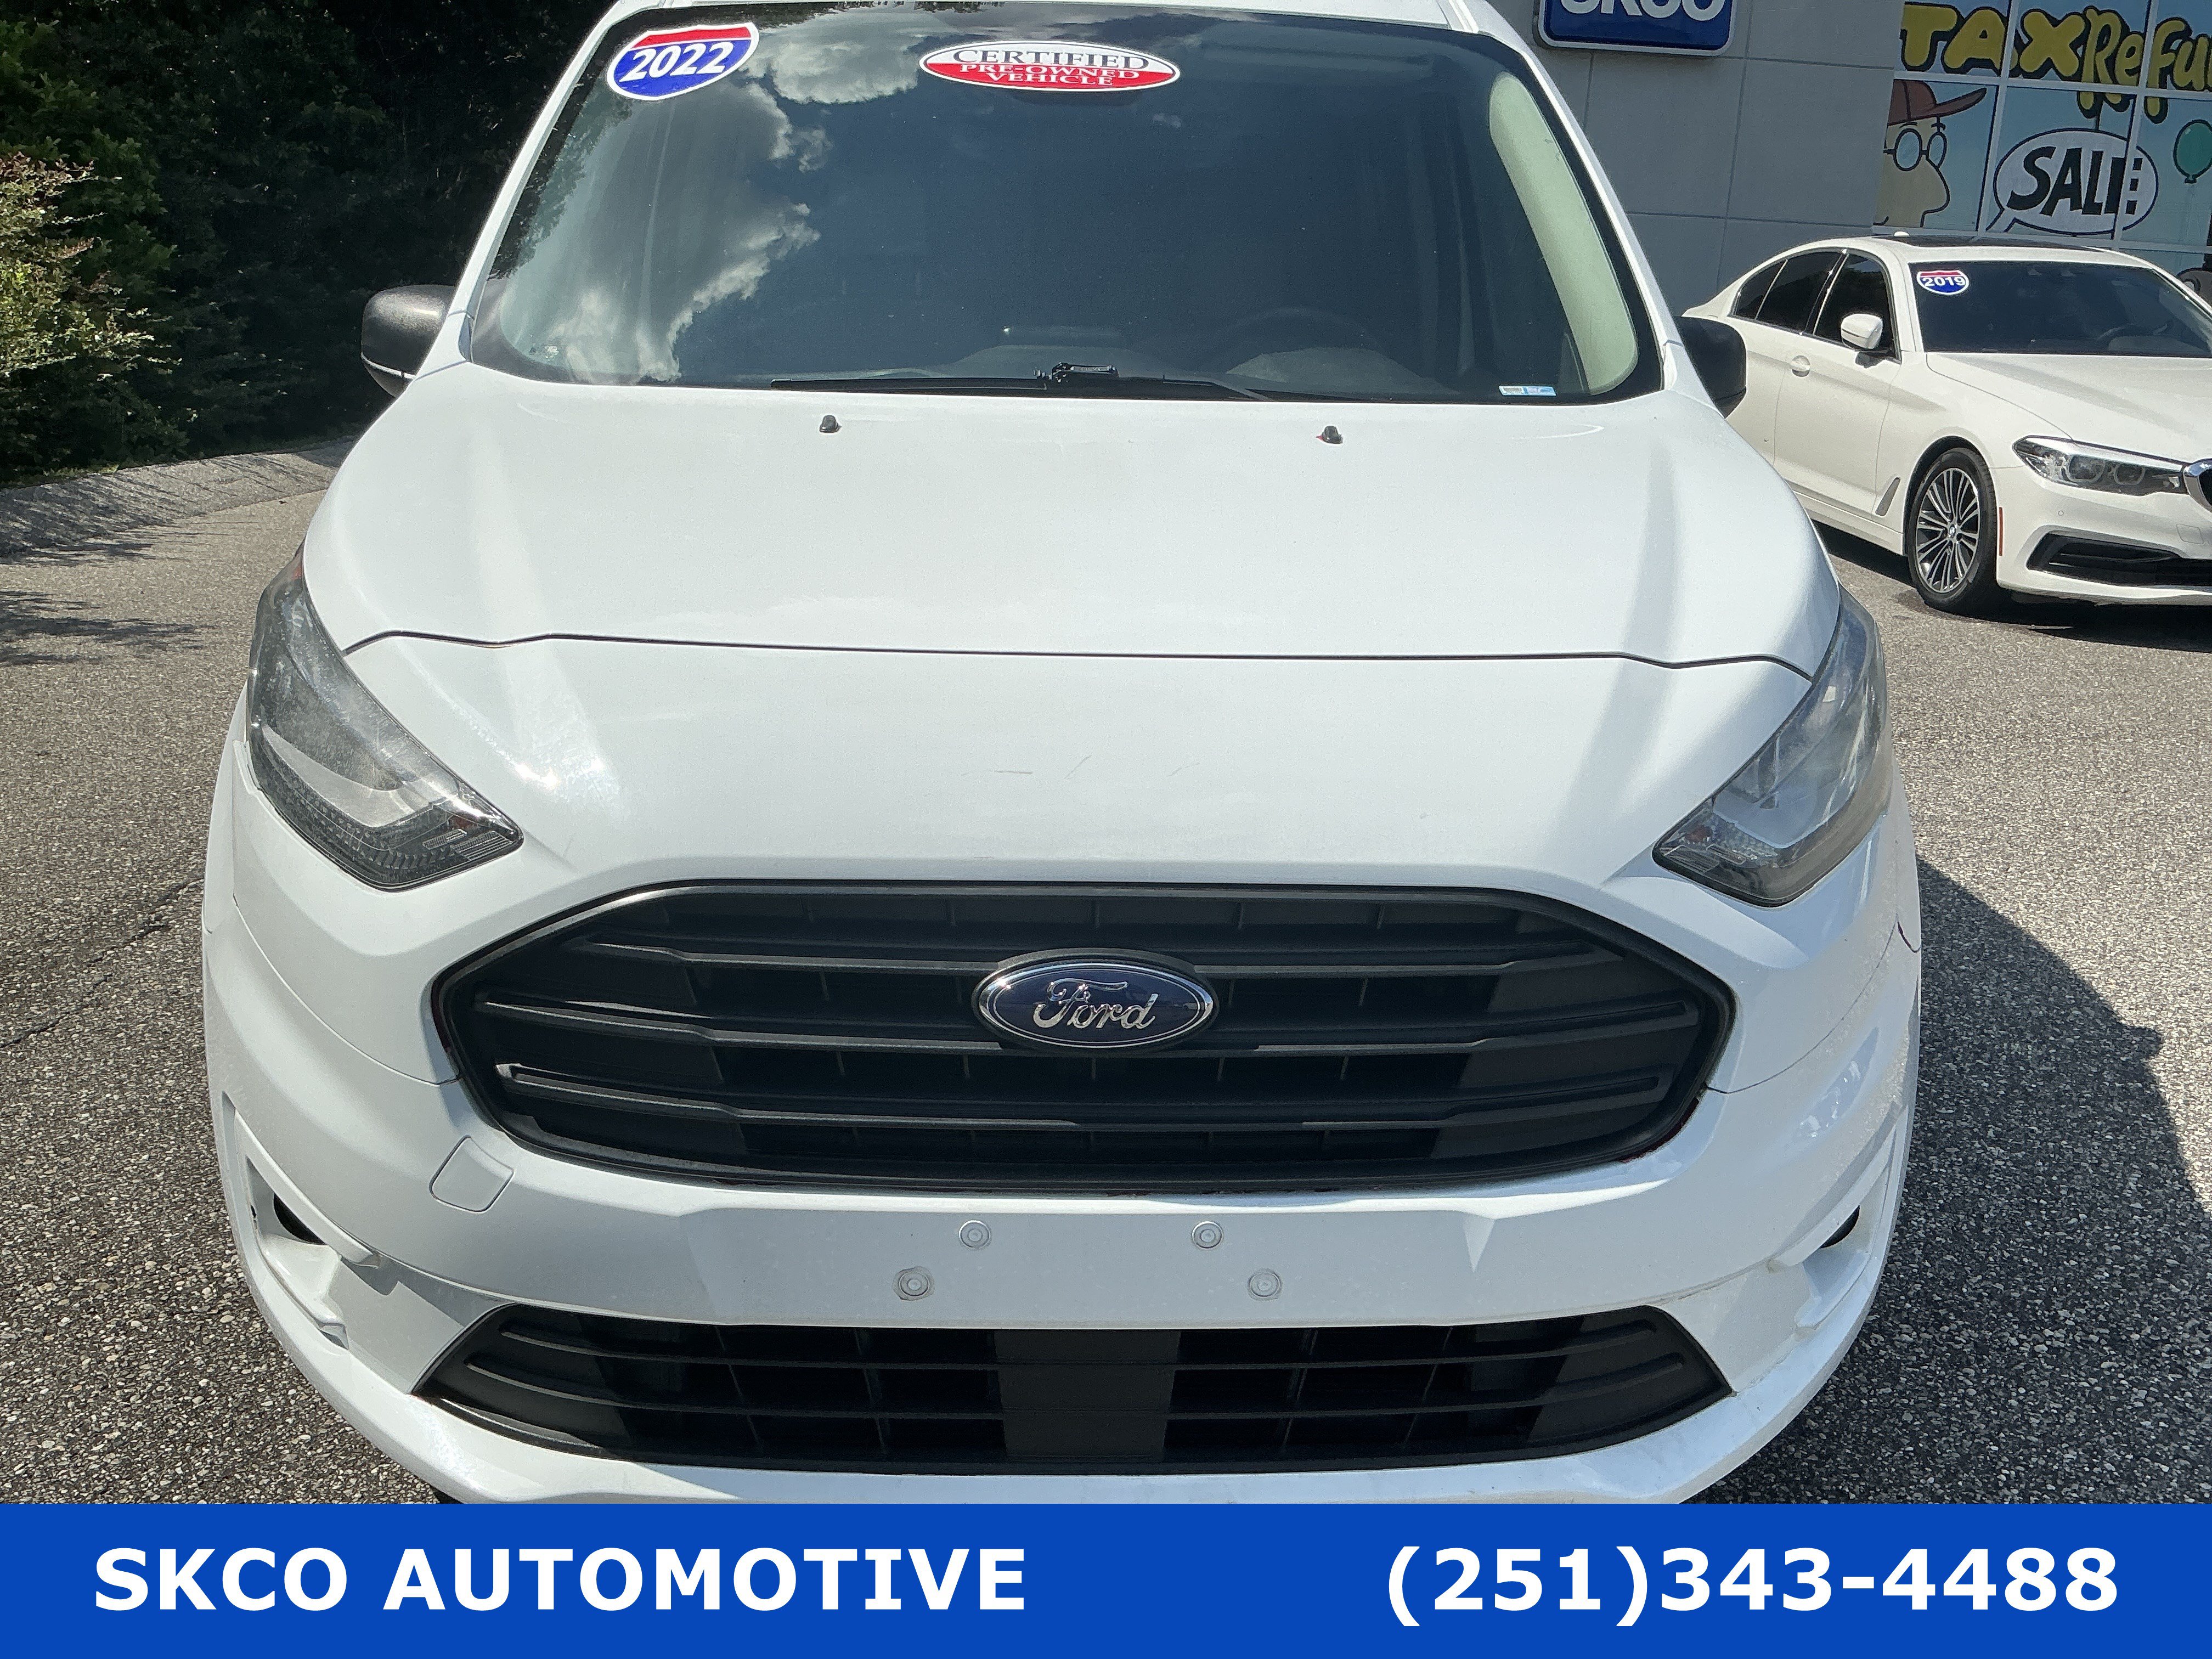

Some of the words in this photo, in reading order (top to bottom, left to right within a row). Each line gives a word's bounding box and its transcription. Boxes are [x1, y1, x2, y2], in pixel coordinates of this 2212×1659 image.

[619, 41, 734, 82] 2022
[953, 49, 1149, 70] CERTIFIED
[960, 64, 1139, 79] PRE-OWNED
[1900, 2, 2084, 80] TAX
[2078, 5, 2212, 118] Refu
[987, 72, 1113, 86] VEHICLE
[2006, 145, 2143, 216] SALE
[1922, 276, 1966, 286] 2019
[1032, 978, 1159, 1029] Ford
